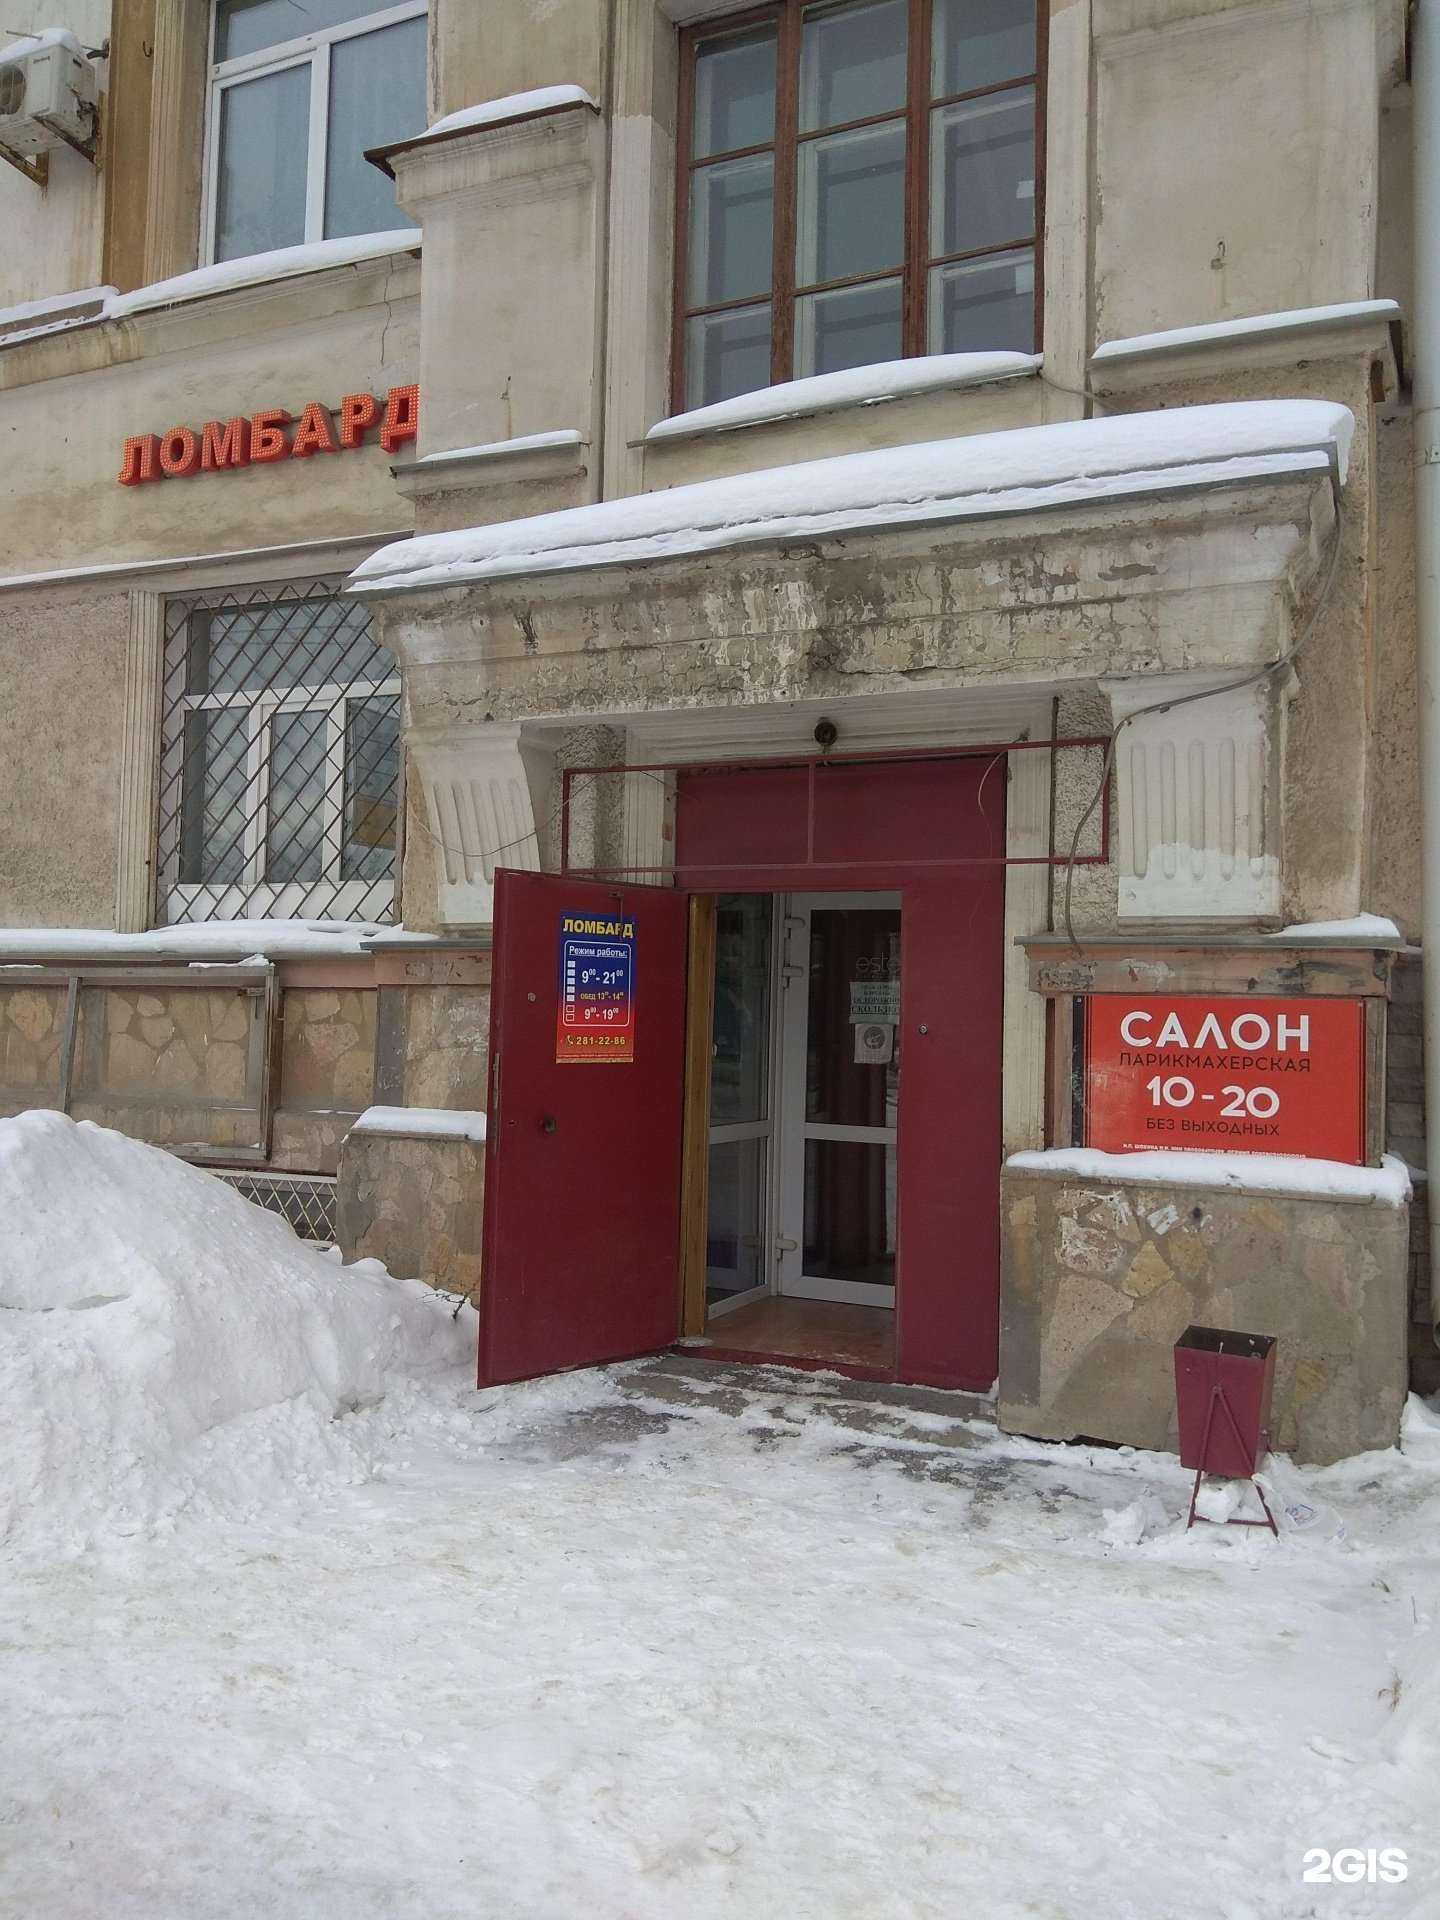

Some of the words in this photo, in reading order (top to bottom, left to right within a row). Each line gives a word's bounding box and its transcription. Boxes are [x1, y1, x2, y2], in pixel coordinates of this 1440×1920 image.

[117, 384, 420, 486] ЛОМБАРД
[569, 945, 595, 956] Режим
[597, 948, 629, 958] работы:
[1120, 1011, 1310, 1052] САЛОН
[1119, 1052, 1311, 1072] ПАРИКМАХЕРСКАЯ
[1146, 1117, 1176, 1130] БЕЗ
[1181, 1119, 1280, 1136] ВЫХОДНЫХ
